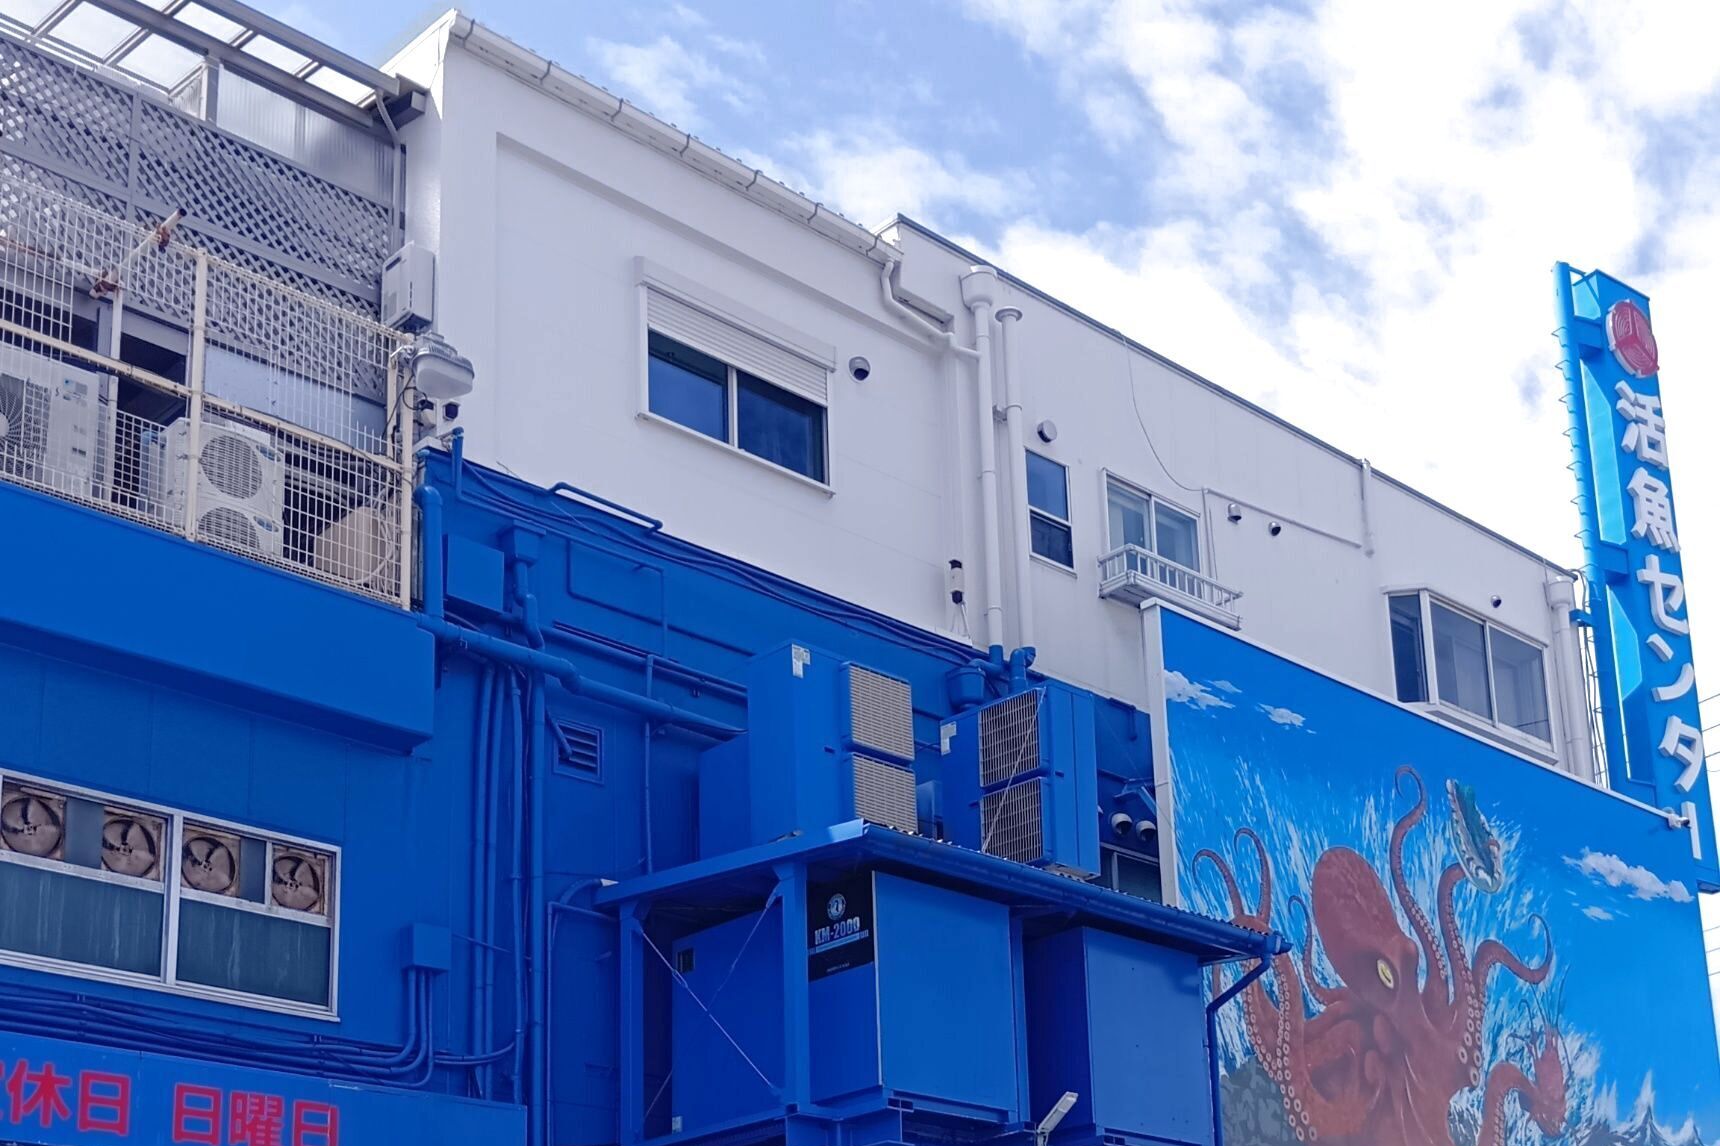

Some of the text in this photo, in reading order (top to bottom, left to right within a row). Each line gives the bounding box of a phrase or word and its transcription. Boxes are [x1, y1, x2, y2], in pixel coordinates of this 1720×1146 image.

[1616, 380, 1704, 860] 活魚センター
[815, 917, 860, 944] KM-2000
[0, 1058, 131, 1137] 休日
